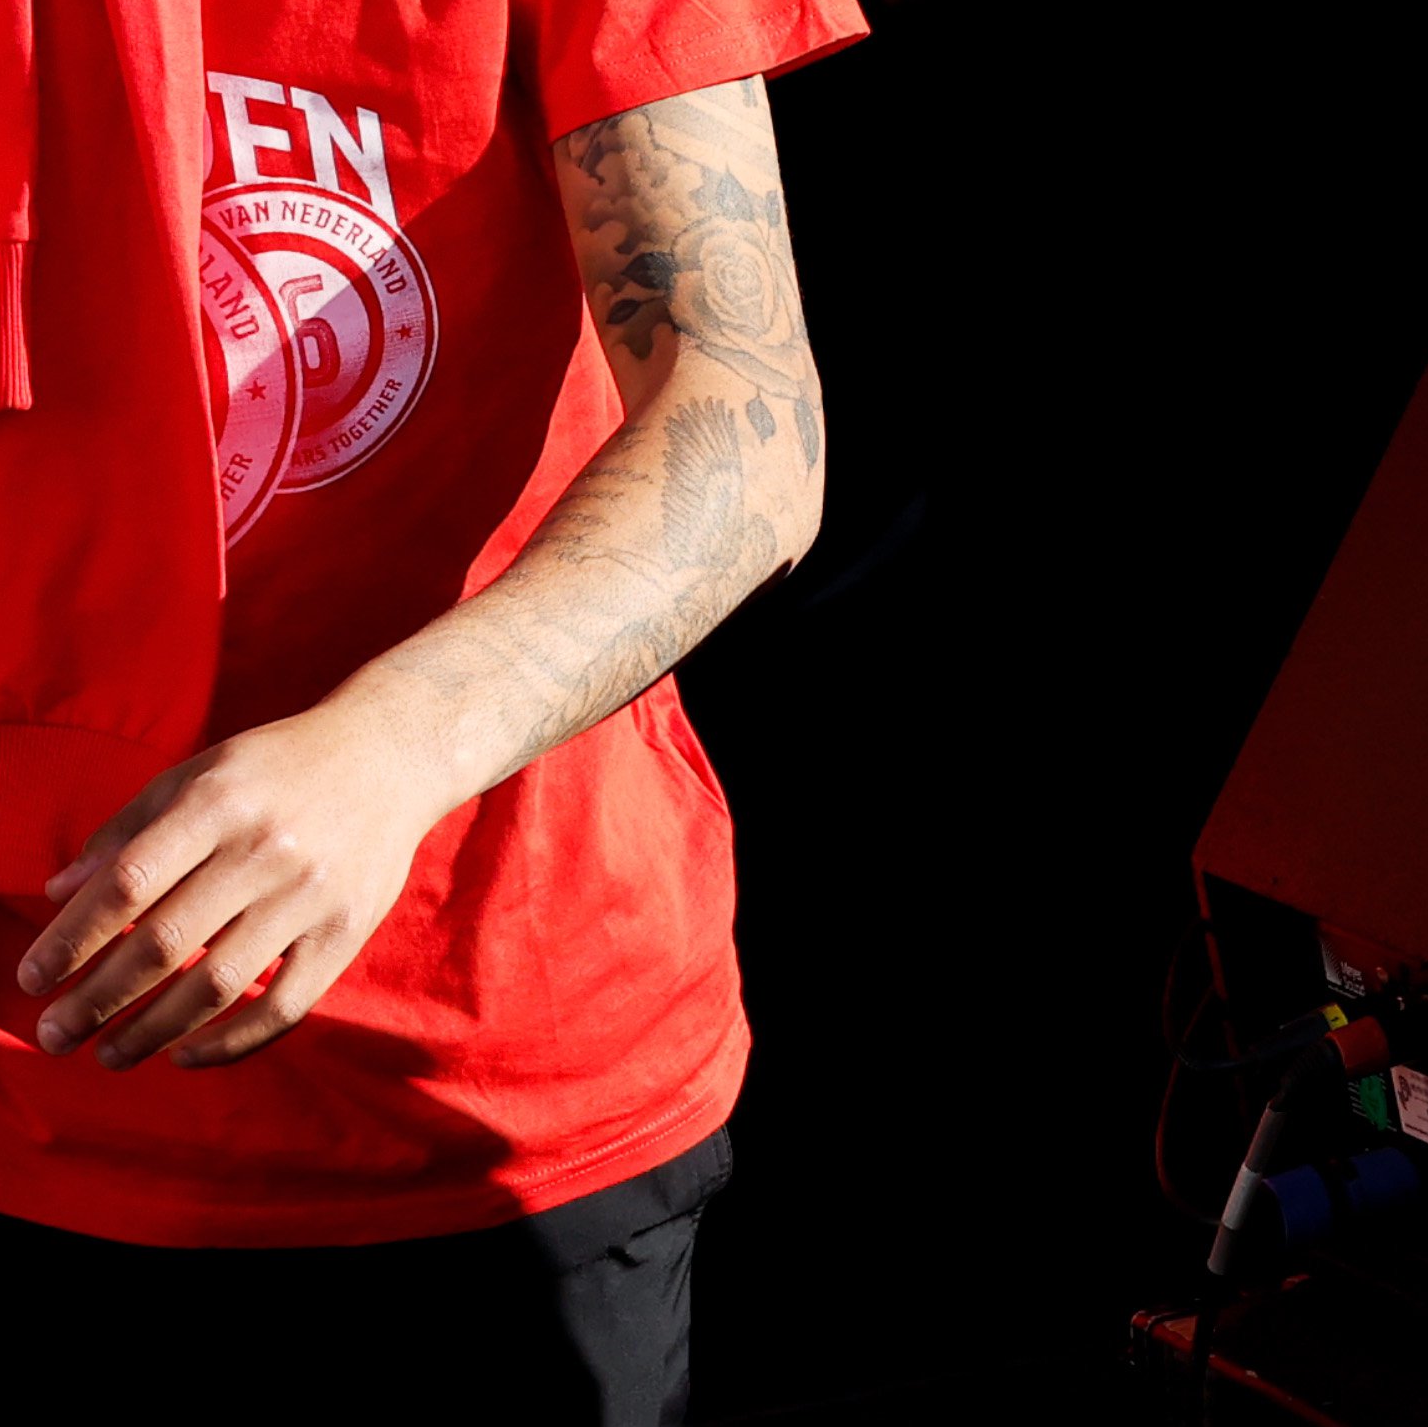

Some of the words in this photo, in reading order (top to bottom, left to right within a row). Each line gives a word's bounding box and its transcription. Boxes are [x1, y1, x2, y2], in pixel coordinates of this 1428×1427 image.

[219, 201, 269, 229] VAN
[281, 200, 407, 294] NEDERLAND
[199, 252, 259, 340] LAND
[291, 445, 326, 468] ARS
[328, 378, 402, 453] TOGETHER
[221, 452, 253, 502] HER
